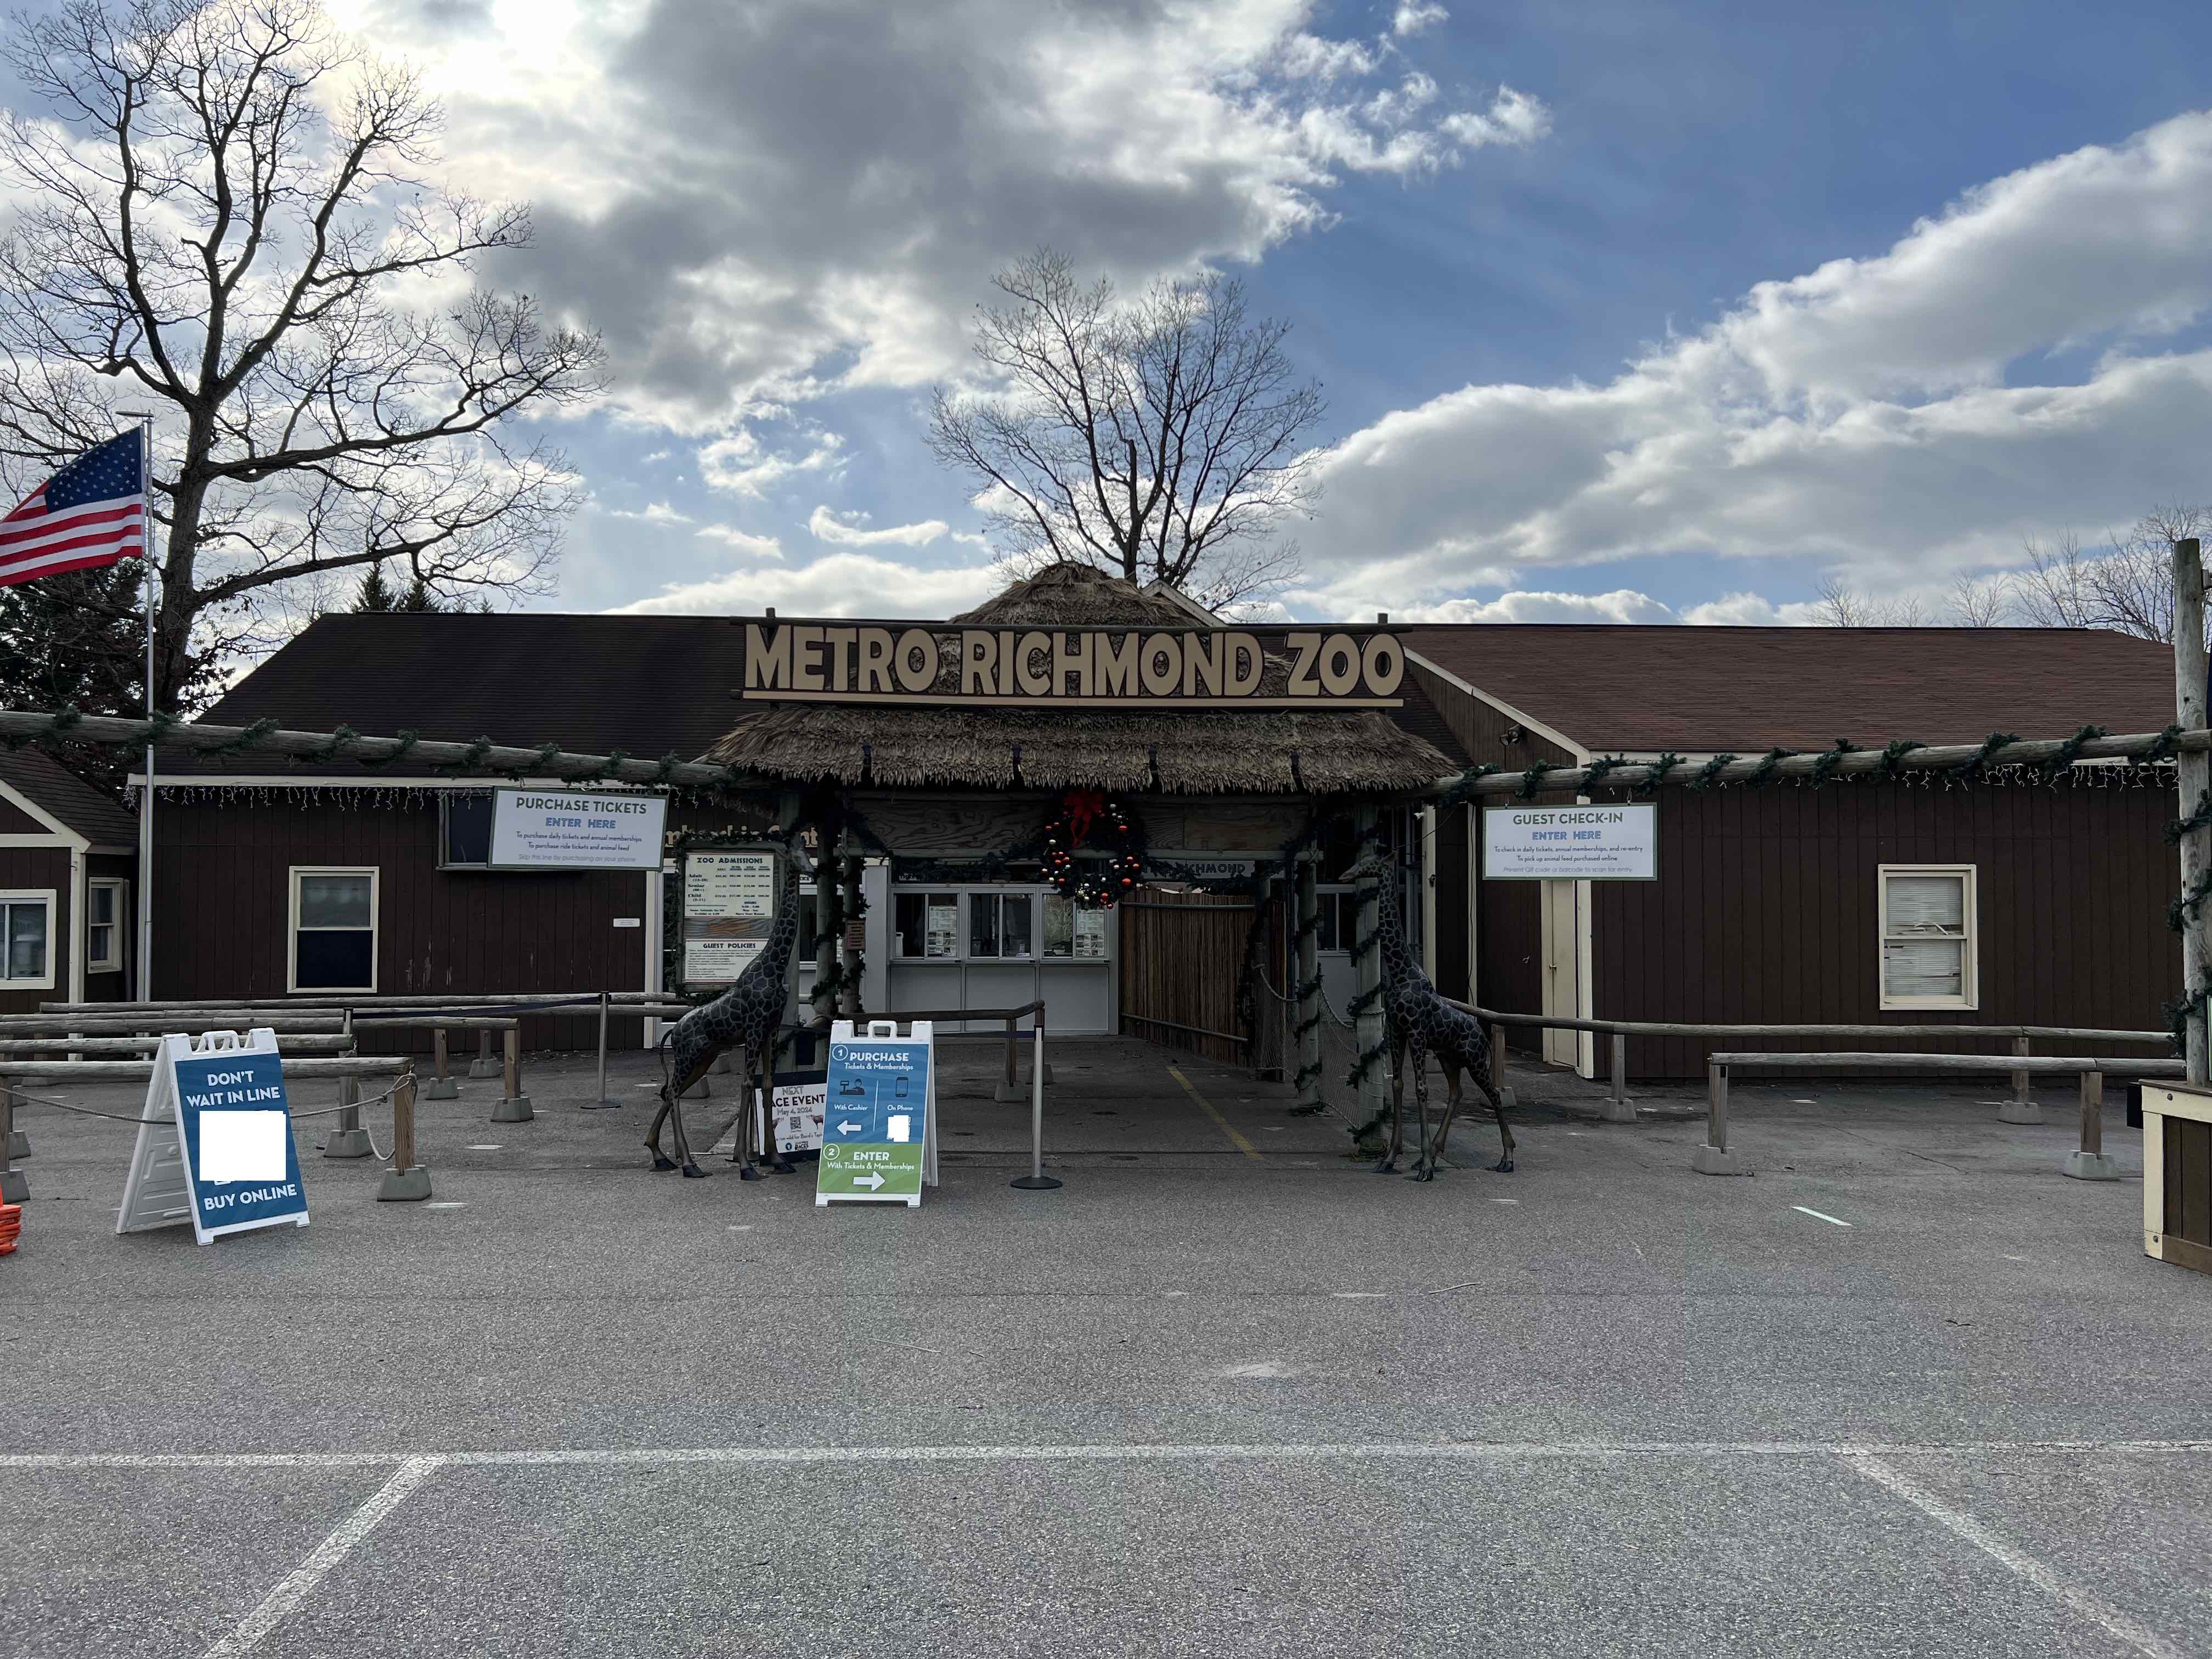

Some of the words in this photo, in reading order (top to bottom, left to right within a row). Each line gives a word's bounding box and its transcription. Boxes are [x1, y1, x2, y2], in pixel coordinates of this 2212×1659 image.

[745, 624, 938, 692] METRO
[961, 630, 1262, 696] RICHMOND
[1286, 633, 1404, 696] ZOO
[516, 797, 590, 811] PURCHASE
[593, 801, 647, 814] TICKETS
[545, 817, 582, 827] ENTER
[588, 819, 617, 828] HERE
[1513, 814, 1556, 825] GUEST
[1559, 812, 1623, 824] CHECK-IN
[524, 831, 548, 840] purchase
[549, 832, 561, 840] daily
[609, 834, 642, 843] memberships
[1532, 832, 1567, 840] ENTER
[1573, 831, 1601, 840] HERE
[1522, 845, 1534, 854] daily
[1573, 854, 1600, 862] purchased
[1184, 864, 1246, 873] CHMOND
[850, 1052, 909, 1062] PURCHASE
[207, 1070, 254, 1086] DON'T
[782, 1086, 804, 1096] NEXT
[187, 1092, 224, 1108] WAIT
[228, 1090, 245, 1104] IN
[247, 1086, 280, 1102] LINE
[764, 1097, 789, 1108] ACE
[792, 1094, 825, 1106] EVENT
[777, 1108, 789, 1116] May
[854, 1152, 890, 1161] ENTER
[204, 1193, 235, 1211] BUY
[240, 1184, 297, 1204] ONLINE
